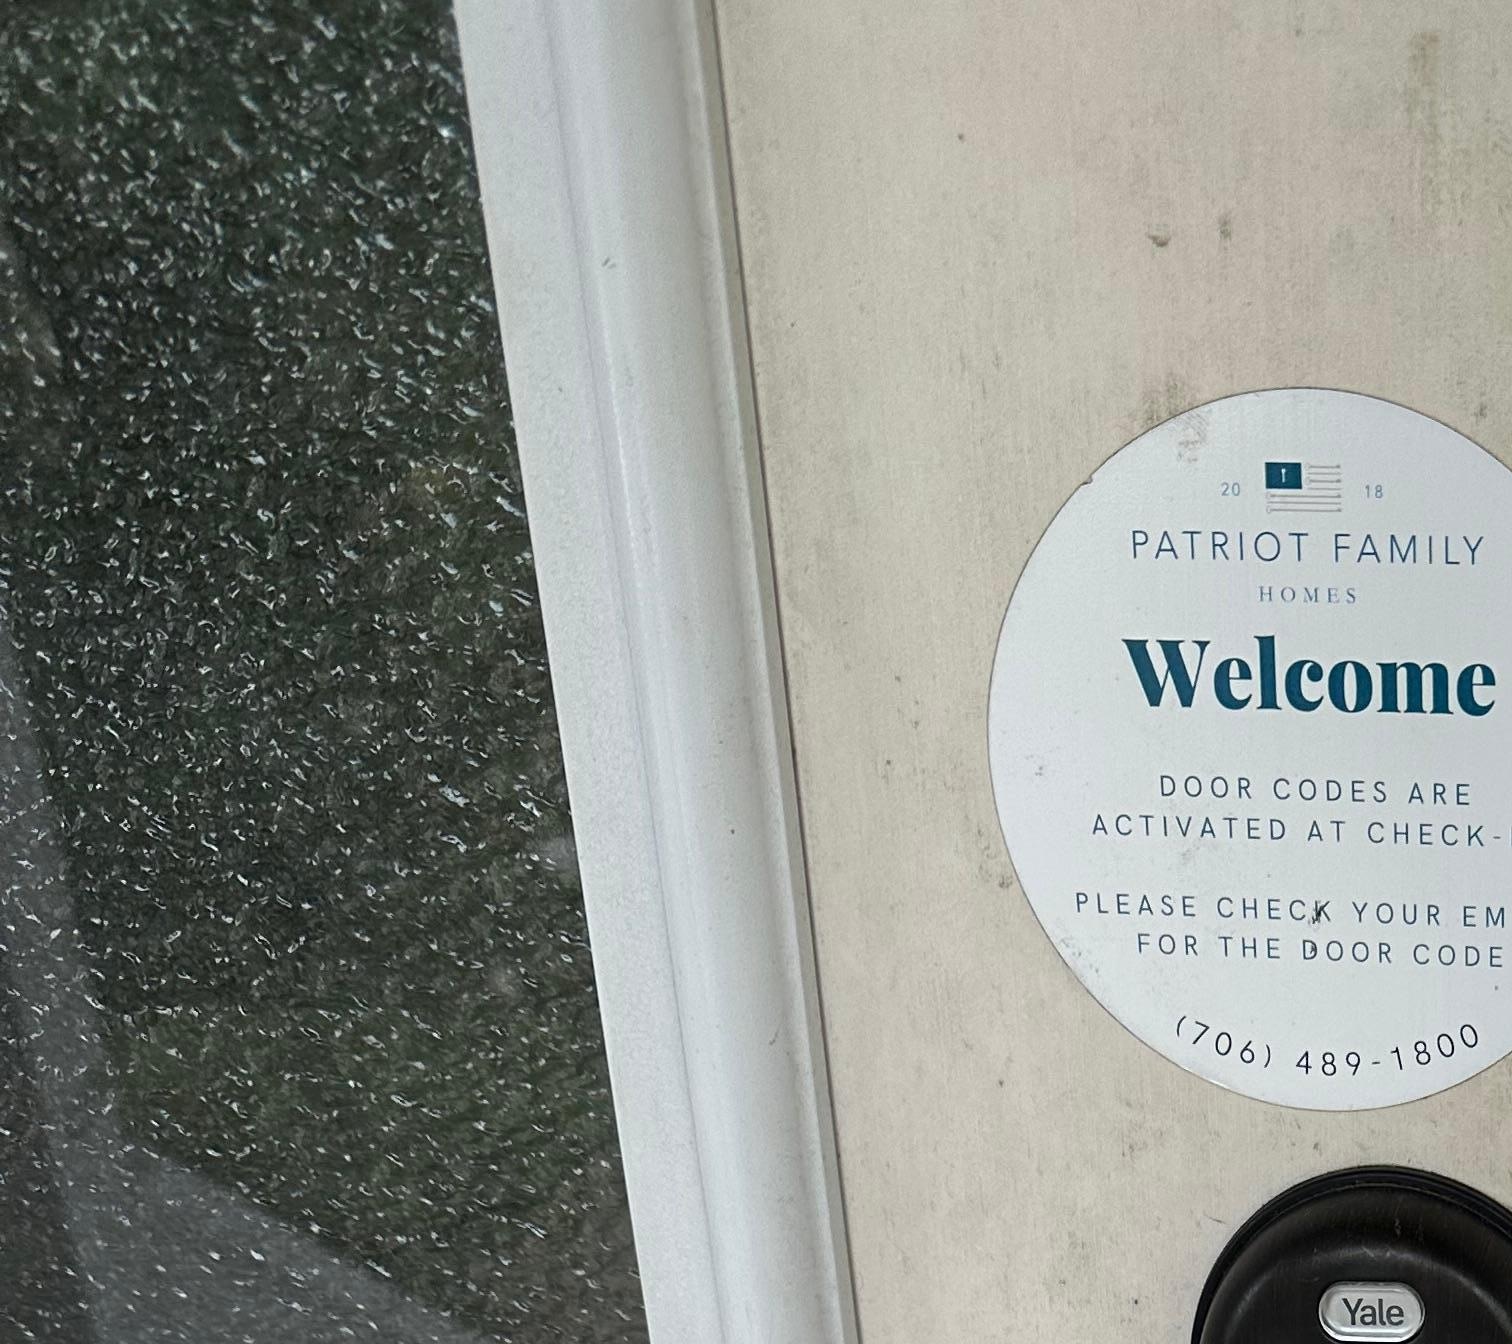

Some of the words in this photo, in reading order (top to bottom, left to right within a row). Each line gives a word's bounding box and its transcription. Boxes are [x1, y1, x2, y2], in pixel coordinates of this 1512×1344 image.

[1221, 482, 1240, 496] 20
[1365, 484, 1384, 499] 18
[1132, 530, 1309, 562] PATRIOT
[1334, 533, 1484, 565] FAMILY
[1259, 586, 1356, 604] HOMES
[1121, 635, 1496, 717] Welcome
[1160, 775, 1252, 799] DOOR
[1273, 778, 1386, 803] CODES
[1408, 782, 1470, 805] ARE
[1092, 814, 1285, 840] ACTIVATED
[1308, 820, 1346, 842] AT
[1076, 892, 1196, 917] PLEASE
[1217, 897, 1331, 924] CHECK
[1352, 901, 1440, 926] YOUR
[1138, 933, 1198, 956] FOR
[1218, 936, 1280, 959] THE
[1302, 939, 1392, 964] DOOR
[1413, 944, 1503, 967] CODE
[1175, 1015, 1272, 1068] (706)
[1296, 1024, 1479, 1076] 489-1800
[1342, 1298, 1404, 1326] Yale
